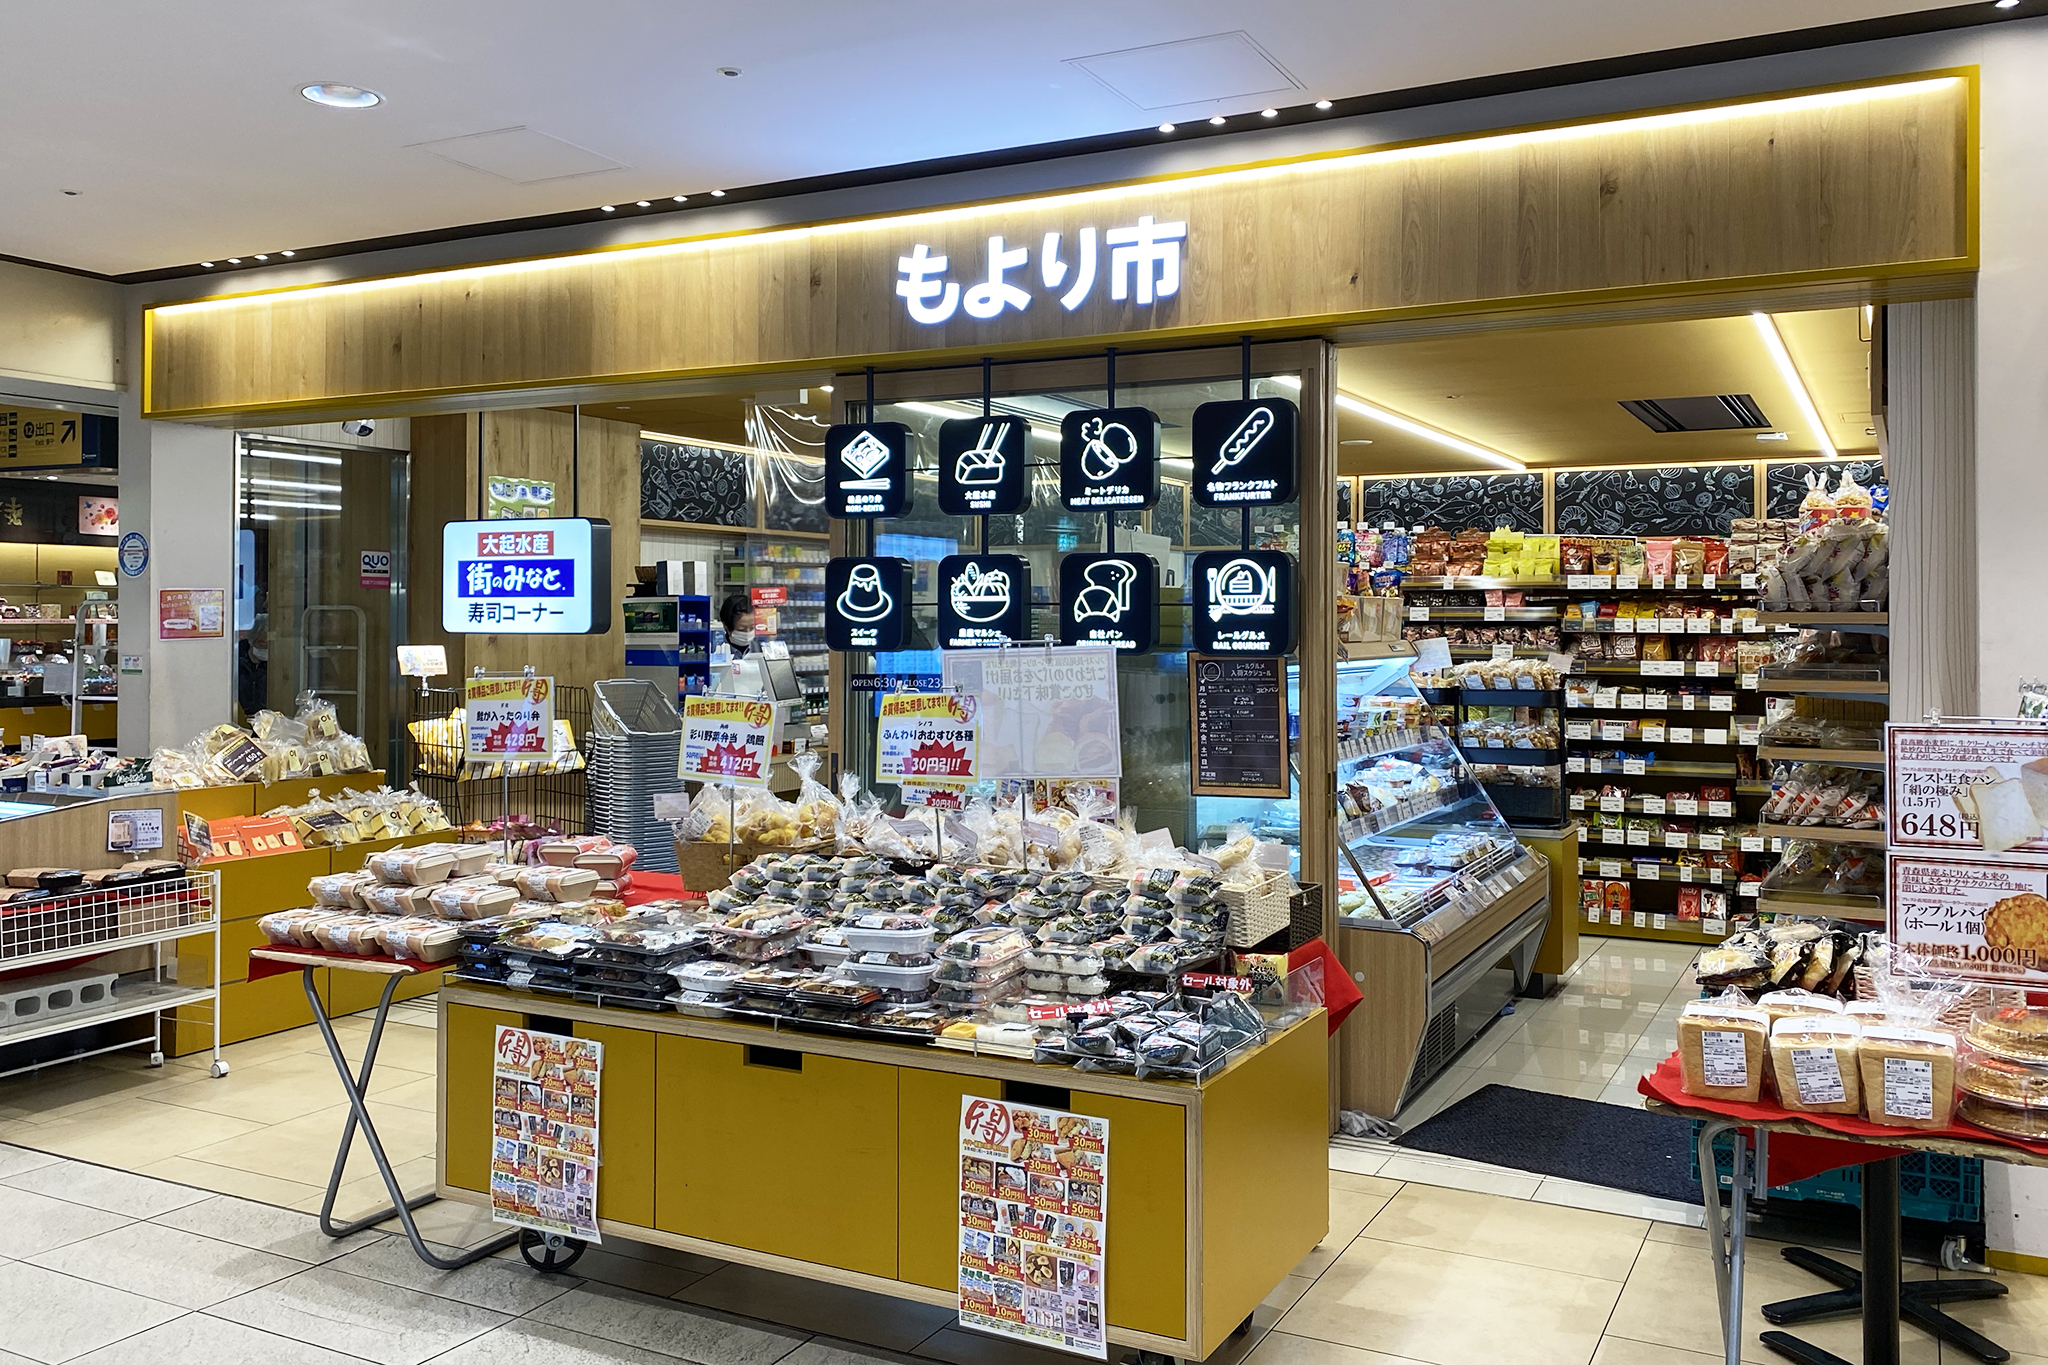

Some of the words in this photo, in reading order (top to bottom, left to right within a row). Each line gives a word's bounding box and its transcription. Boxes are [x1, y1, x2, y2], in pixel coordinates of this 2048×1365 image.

[896, 216, 1187, 324] もより市
[35, 421, 54, 437] 出口
[1084, 485, 1129, 496] ミートデリカ
[1207, 479, 1278, 491] 名物フランクフルト
[1070, 497, 1089, 506] MEAT
[1091, 494, 1144, 505] DELICATESSEN
[1213, 491, 1272, 502] FRANKFURTER
[970, 500, 991, 508] SUSHI
[482, 532, 549, 556] 大起水産
[362, 554, 389, 569] QUO
[468, 602, 564, 624] 寿司コーナー
[850, 628, 878, 638] スイーツ
[1217, 631, 1266, 641] レールグルメ
[851, 638, 877, 646] SWEETS
[1110, 640, 1136, 649] BREAD
[1213, 641, 1231, 650] RAIL
[1231, 641, 1270, 651] GOURMET
[852, 679, 873, 688] OPEN
[873, 677, 896, 688] 6:30
[904, 680, 928, 688] CLOSE
[1199, 685, 1206, 693] 月
[504, 733, 537, 747] 428円
[689, 728, 738, 743] 彩り野菜弁当
[883, 729, 974, 742] ふんわりおむすび各種
[719, 755, 753, 772] 412円
[911, 757, 961, 773] 30円引!!
[1901, 772, 1997, 786] フレスト生食パン
[1902, 784, 1969, 797] 「絹の極み」
[1902, 797, 1941, 808] (1.5斤)
[1901, 813, 1979, 839] 648円
[1902, 866, 2009, 881] 青森県産ふじりんご本来の
[1901, 903, 1988, 921] アップルパイ
[1904, 916, 1986, 936] (ホール1個)
[1182, 974, 1252, 991] セール対象外
[1028, 1000, 1113, 1019] セール対象外
[964, 1099, 1011, 1147] 得
[1069, 1236, 1097, 1251] 398円!
